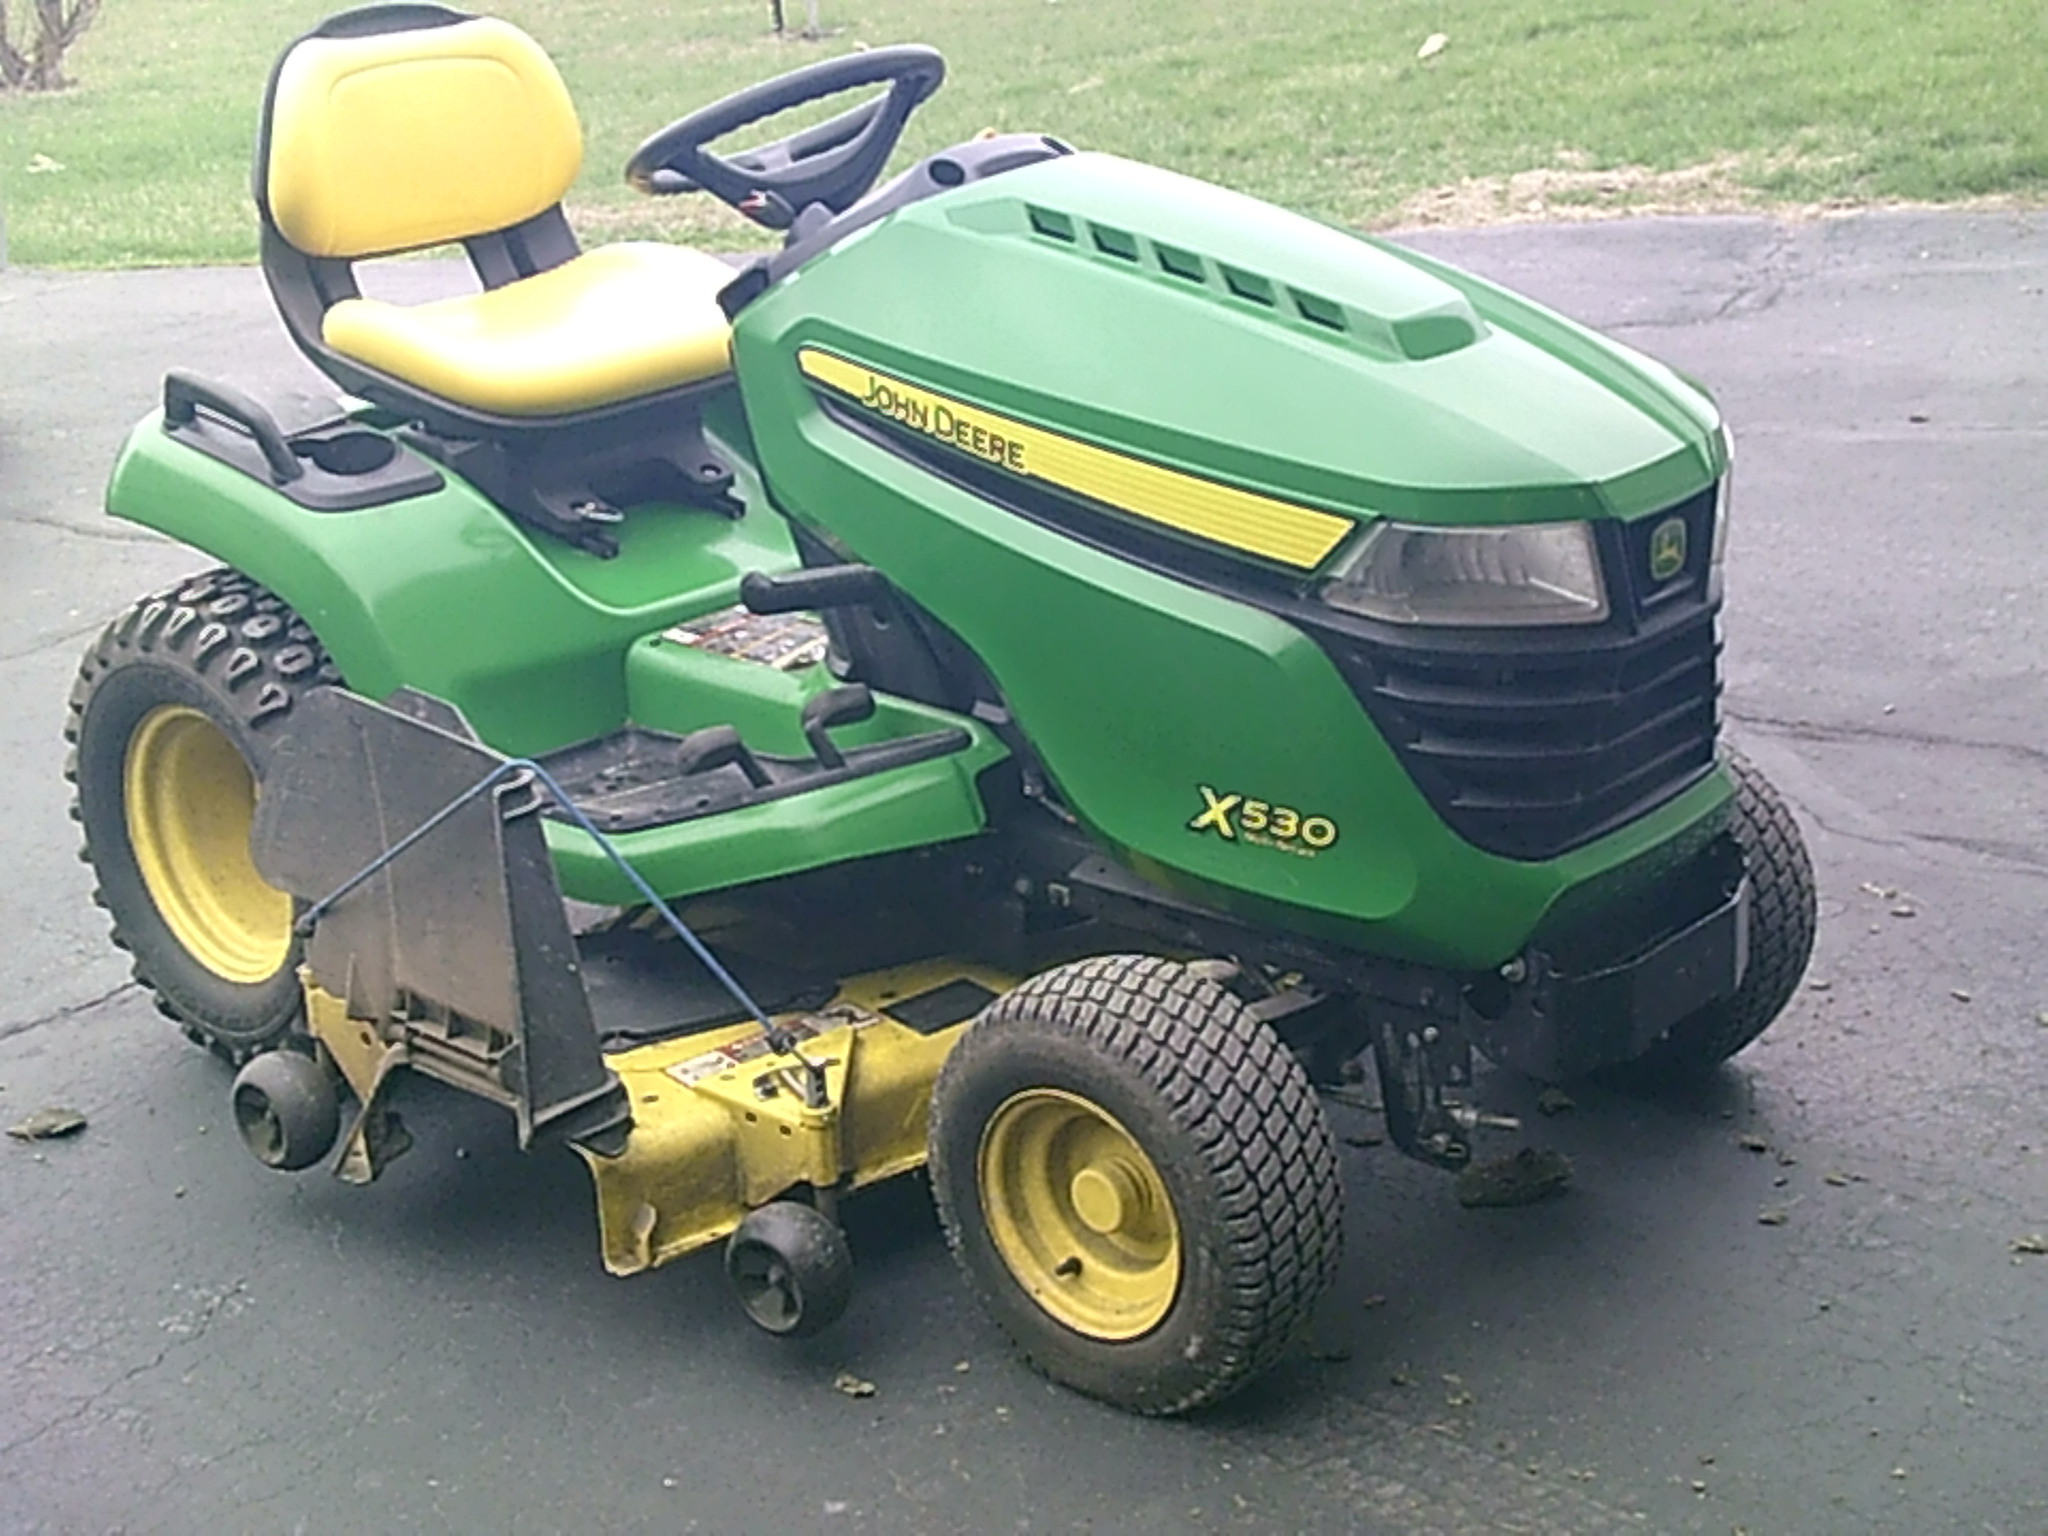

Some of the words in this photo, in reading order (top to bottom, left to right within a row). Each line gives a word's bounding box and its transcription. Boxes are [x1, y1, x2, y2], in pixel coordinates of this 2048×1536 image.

[863, 375, 929, 429] JOHN
[934, 404, 1026, 470] DEERE
[1187, 784, 1338, 848] X530
